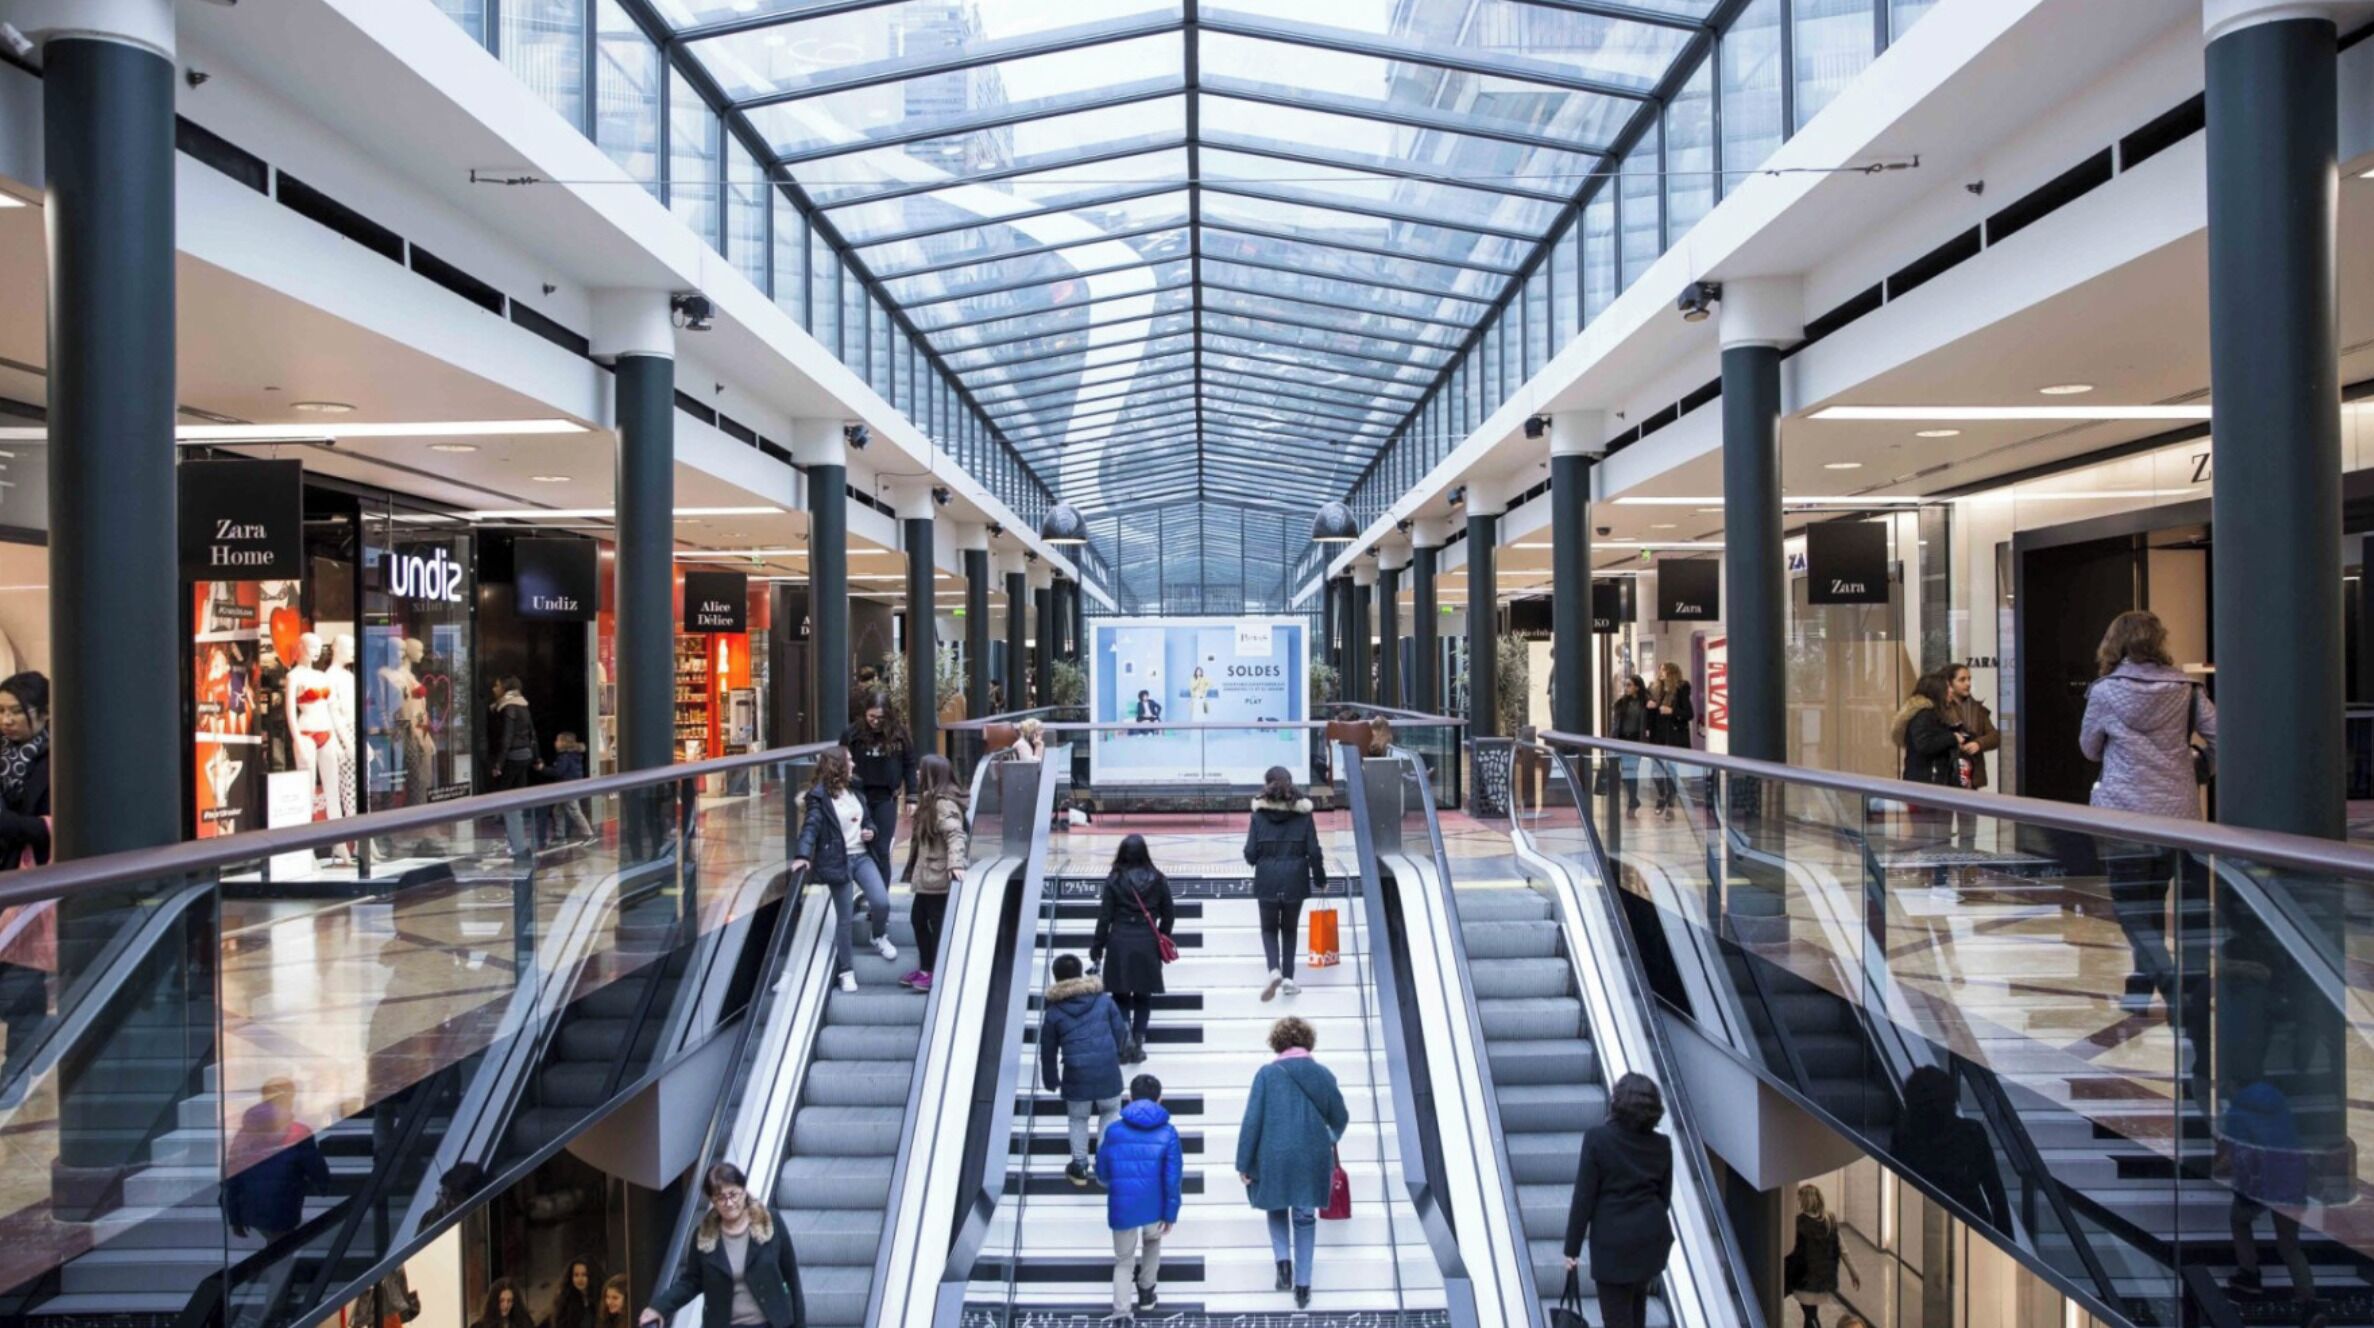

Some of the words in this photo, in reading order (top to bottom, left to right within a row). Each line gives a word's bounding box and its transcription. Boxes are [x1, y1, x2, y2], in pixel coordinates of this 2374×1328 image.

[215, 519, 267, 539] Zara
[210, 545, 275, 566] Home
[391, 548, 463, 602] undiz
[1831, 579, 1866, 594] Zara
[532, 596, 579, 611] Undiz
[700, 601, 731, 613] Alice
[1674, 602, 1703, 614] Zara
[697, 613, 734, 626] Délice
[1227, 665, 1281, 677] SOLDES
